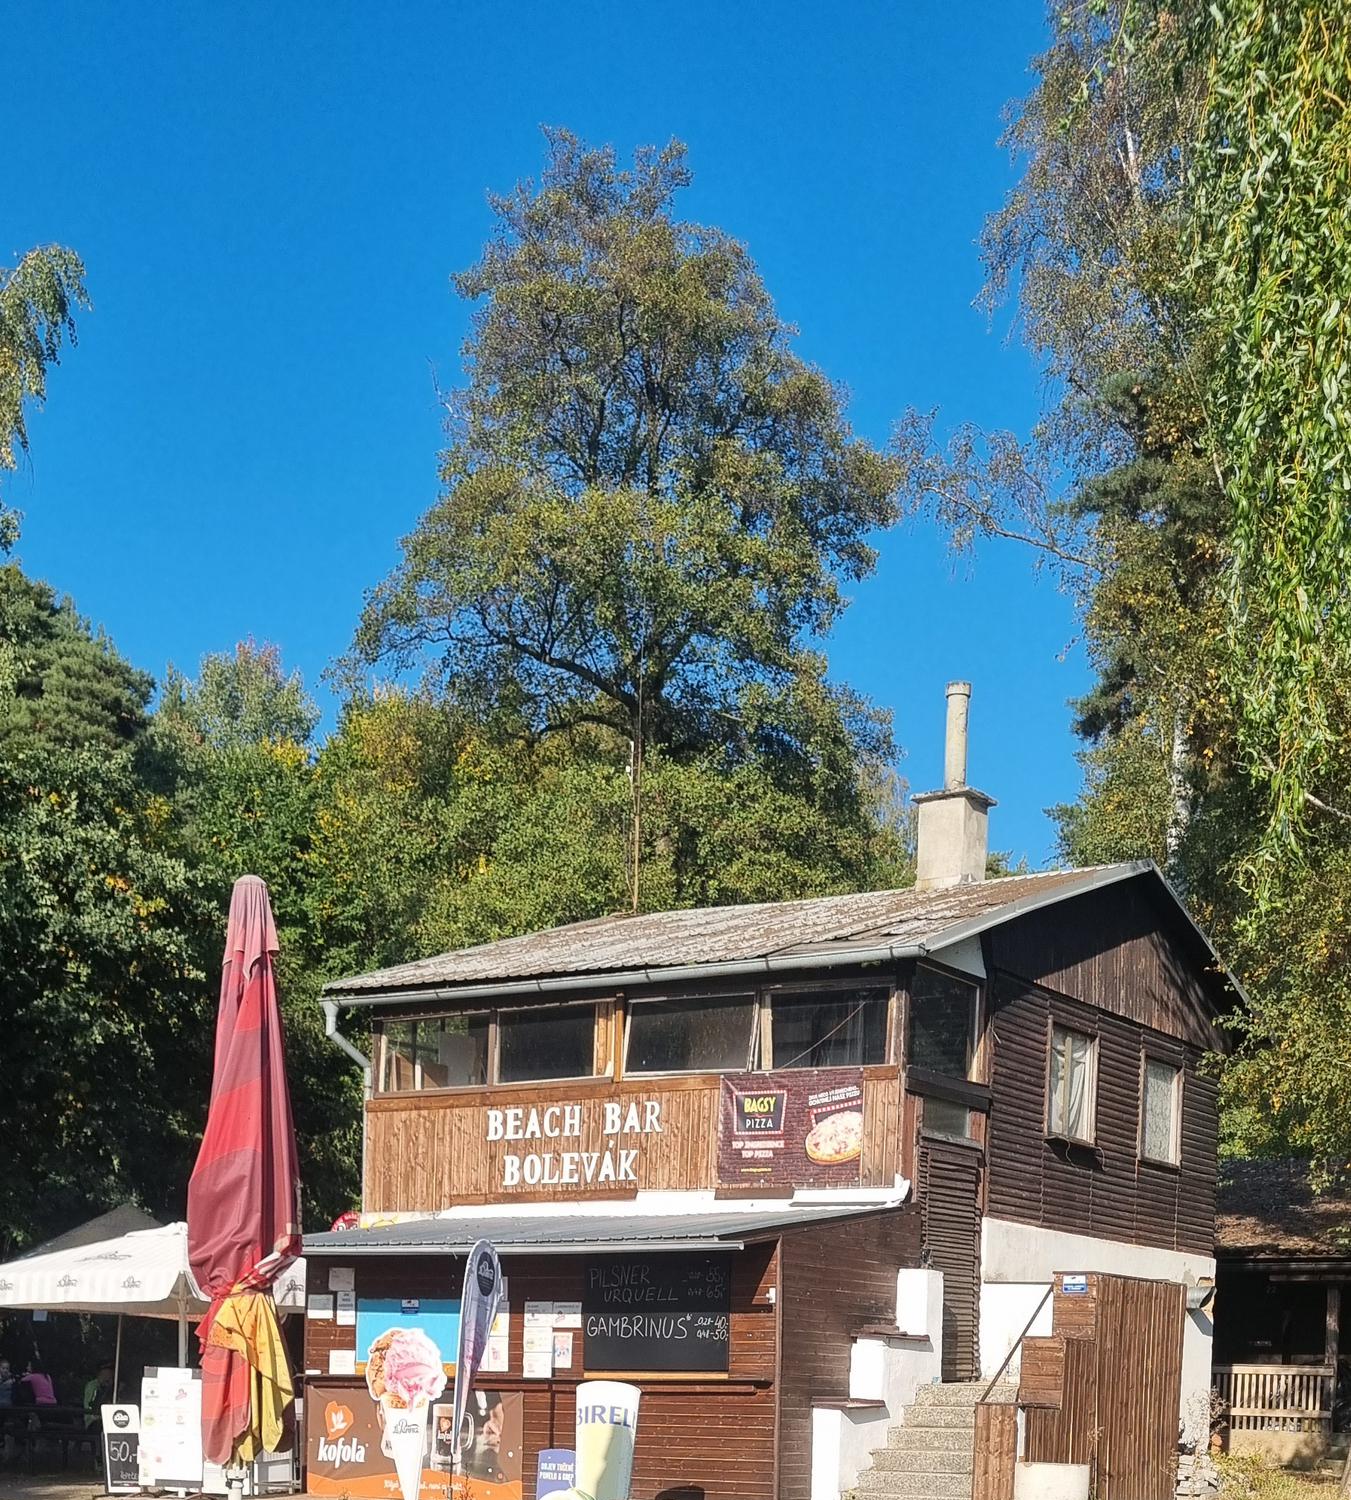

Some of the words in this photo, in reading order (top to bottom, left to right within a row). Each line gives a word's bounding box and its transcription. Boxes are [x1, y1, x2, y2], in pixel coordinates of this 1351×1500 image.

[744, 1097, 776, 1113] BAGSY
[486, 1105, 581, 1141] BEACH
[603, 1101, 663, 1135] BAR
[746, 1119, 773, 1129] PIZZA
[502, 1140, 639, 1186] BOLEVÁK
[741, 1150, 754, 1158] TOP
[754, 1150, 773, 1159] PIZZA
[589, 1264, 650, 1288] PILSNER
[604, 1286, 679, 1304] URQUELL
[587, 1313, 688, 1339] GAMBRINUS
[317, 1436, 365, 1469] kofola
